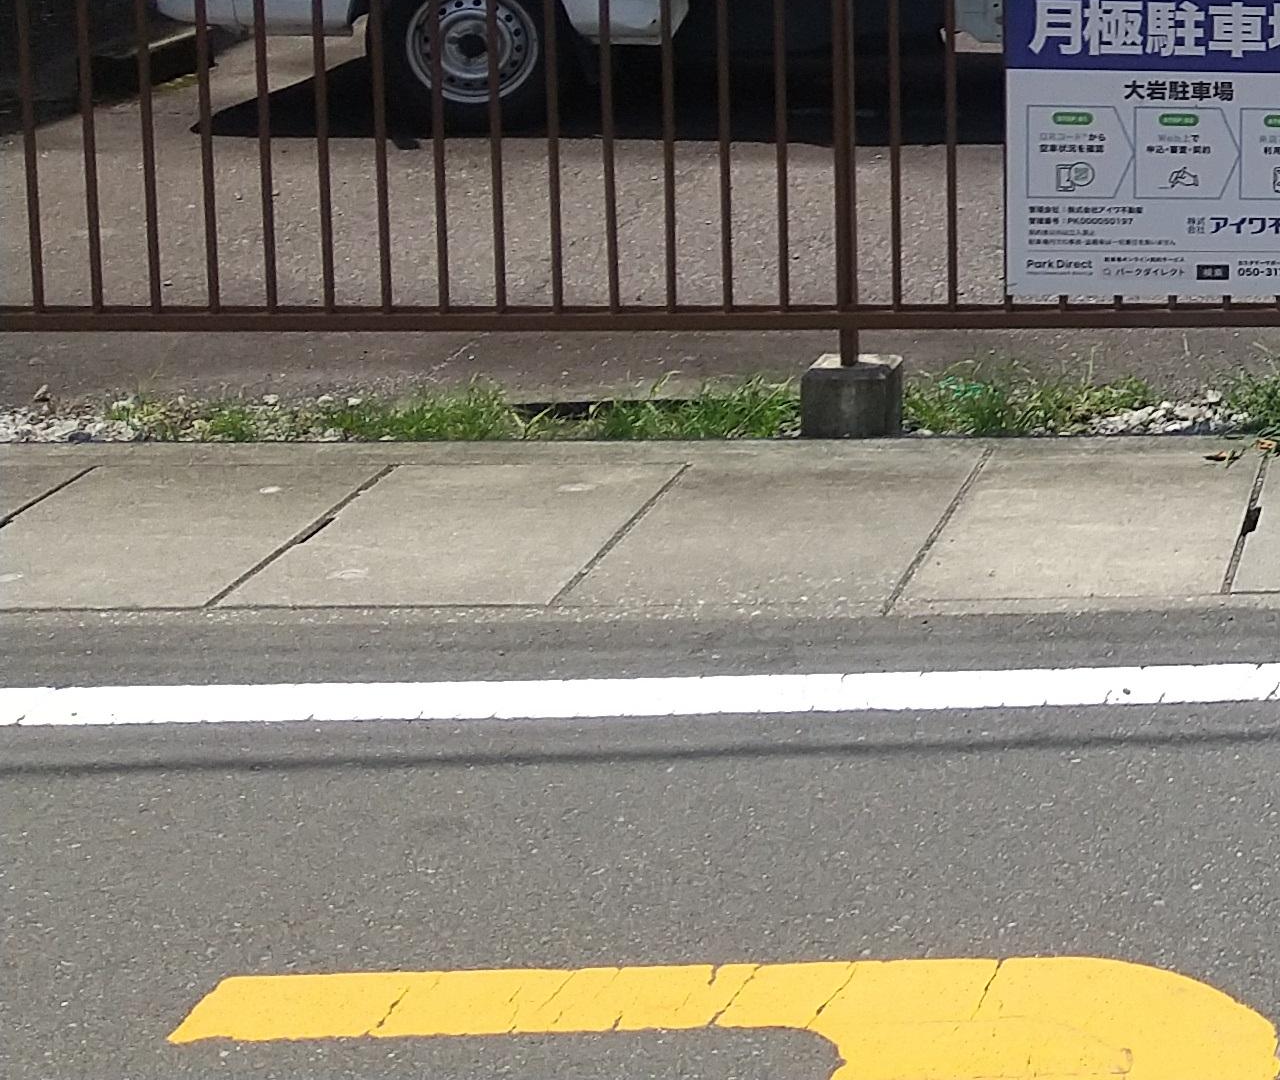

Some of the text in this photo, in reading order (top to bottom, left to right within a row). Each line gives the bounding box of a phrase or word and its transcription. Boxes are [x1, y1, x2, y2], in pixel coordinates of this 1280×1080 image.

[1124, 80, 1234, 101] 大岩駐車場
[1026, 259, 1093, 269] Park Direct
[1115, 267, 1186, 278] パークダイレクト
